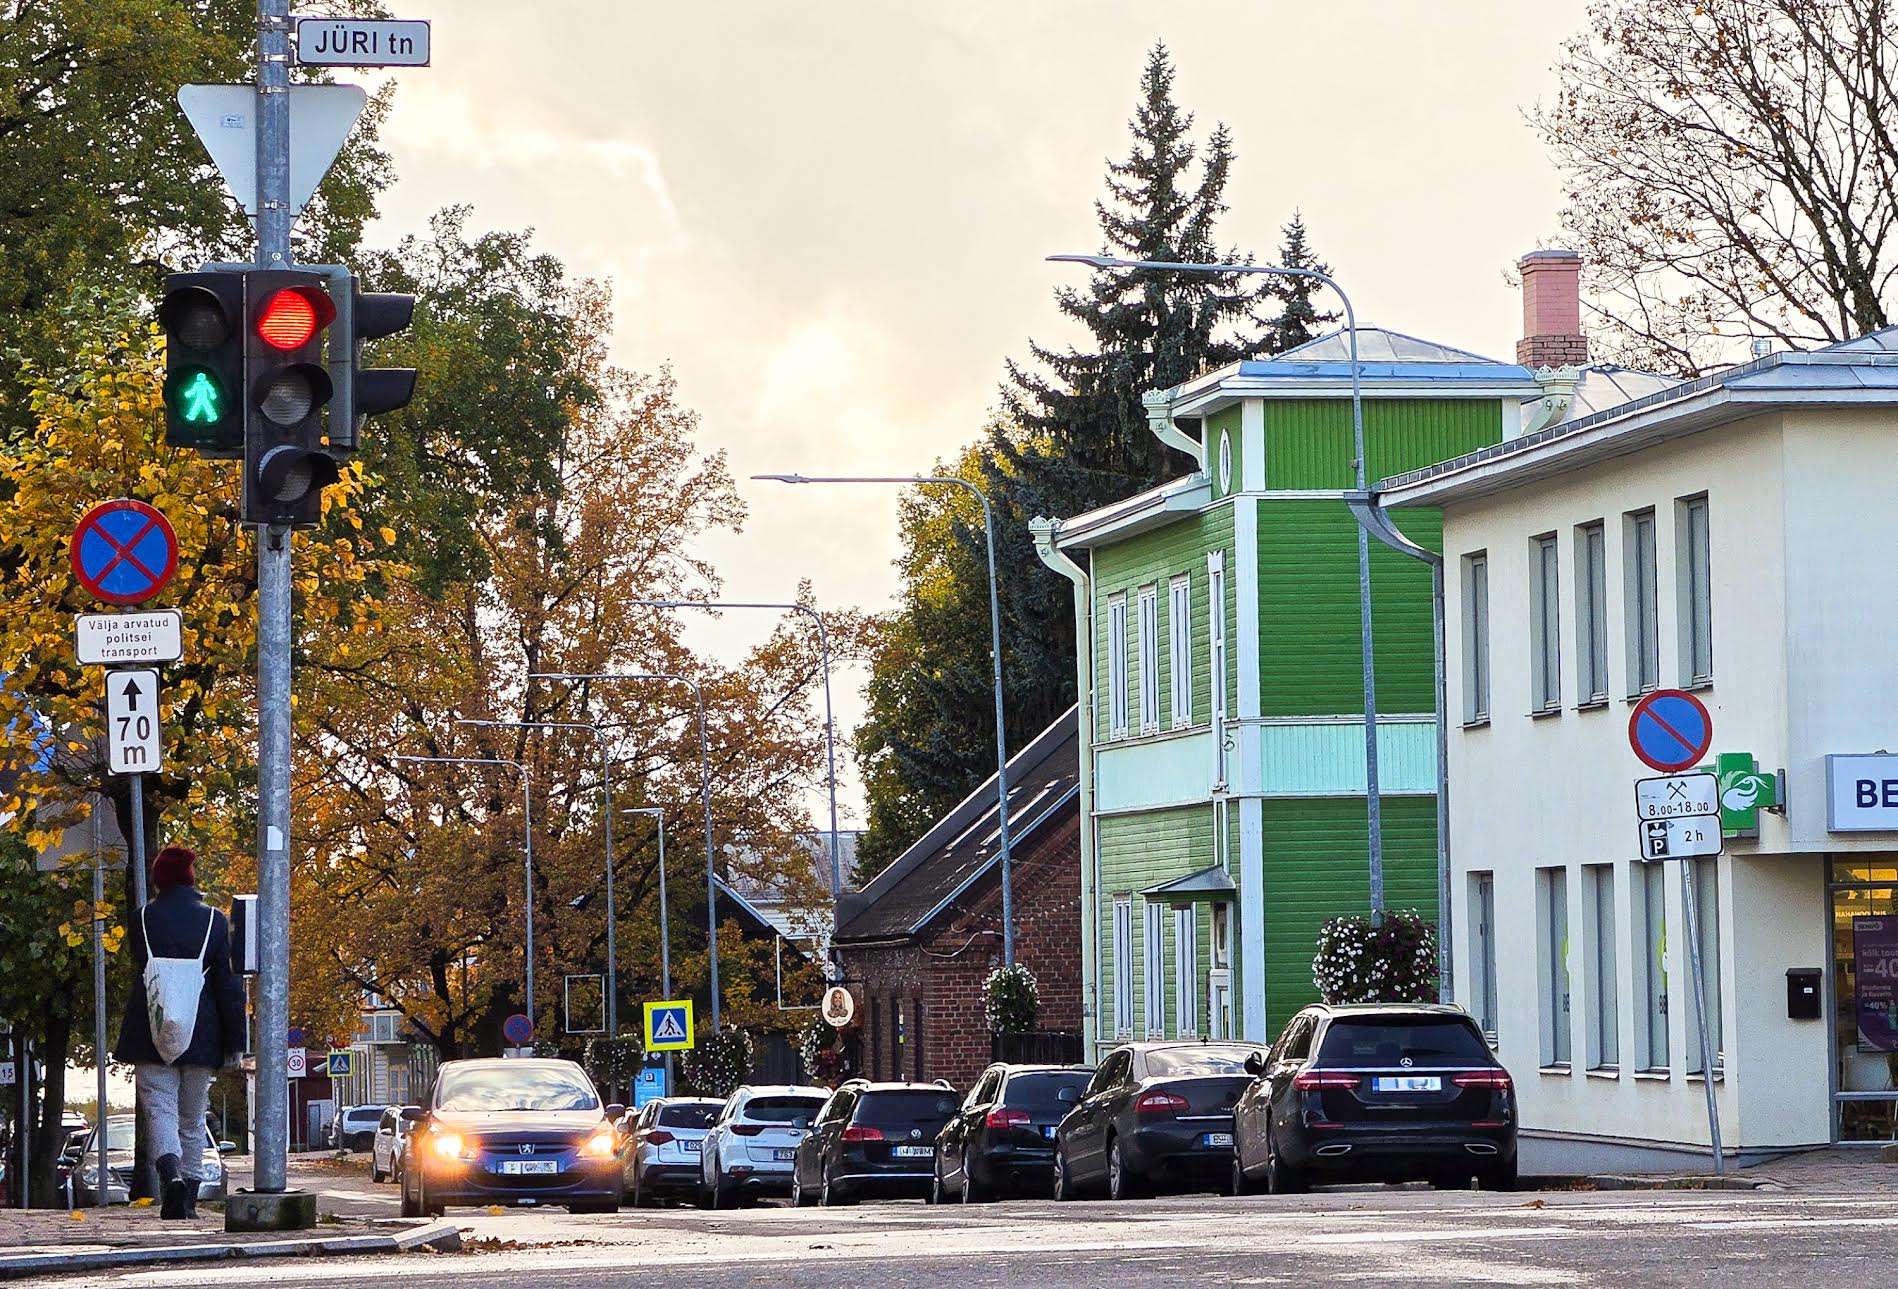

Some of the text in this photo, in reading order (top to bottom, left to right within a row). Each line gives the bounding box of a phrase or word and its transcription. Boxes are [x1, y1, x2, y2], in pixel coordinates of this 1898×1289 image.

[315, 24, 413, 54] JÜRI tn
[89, 618, 169, 631] Välja arvatud
[106, 632, 151, 645] politsei
[101, 646, 157, 658] transport
[117, 716, 150, 741] 70
[123, 746, 146, 764] m
[1856, 779, 1898, 808] BE
[1649, 801, 1709, 816] 8.00-18.00
[1685, 829, 1703, 842] 2 h
[1654, 840, 1664, 854] P
[292, 1059, 302, 1068] 30
